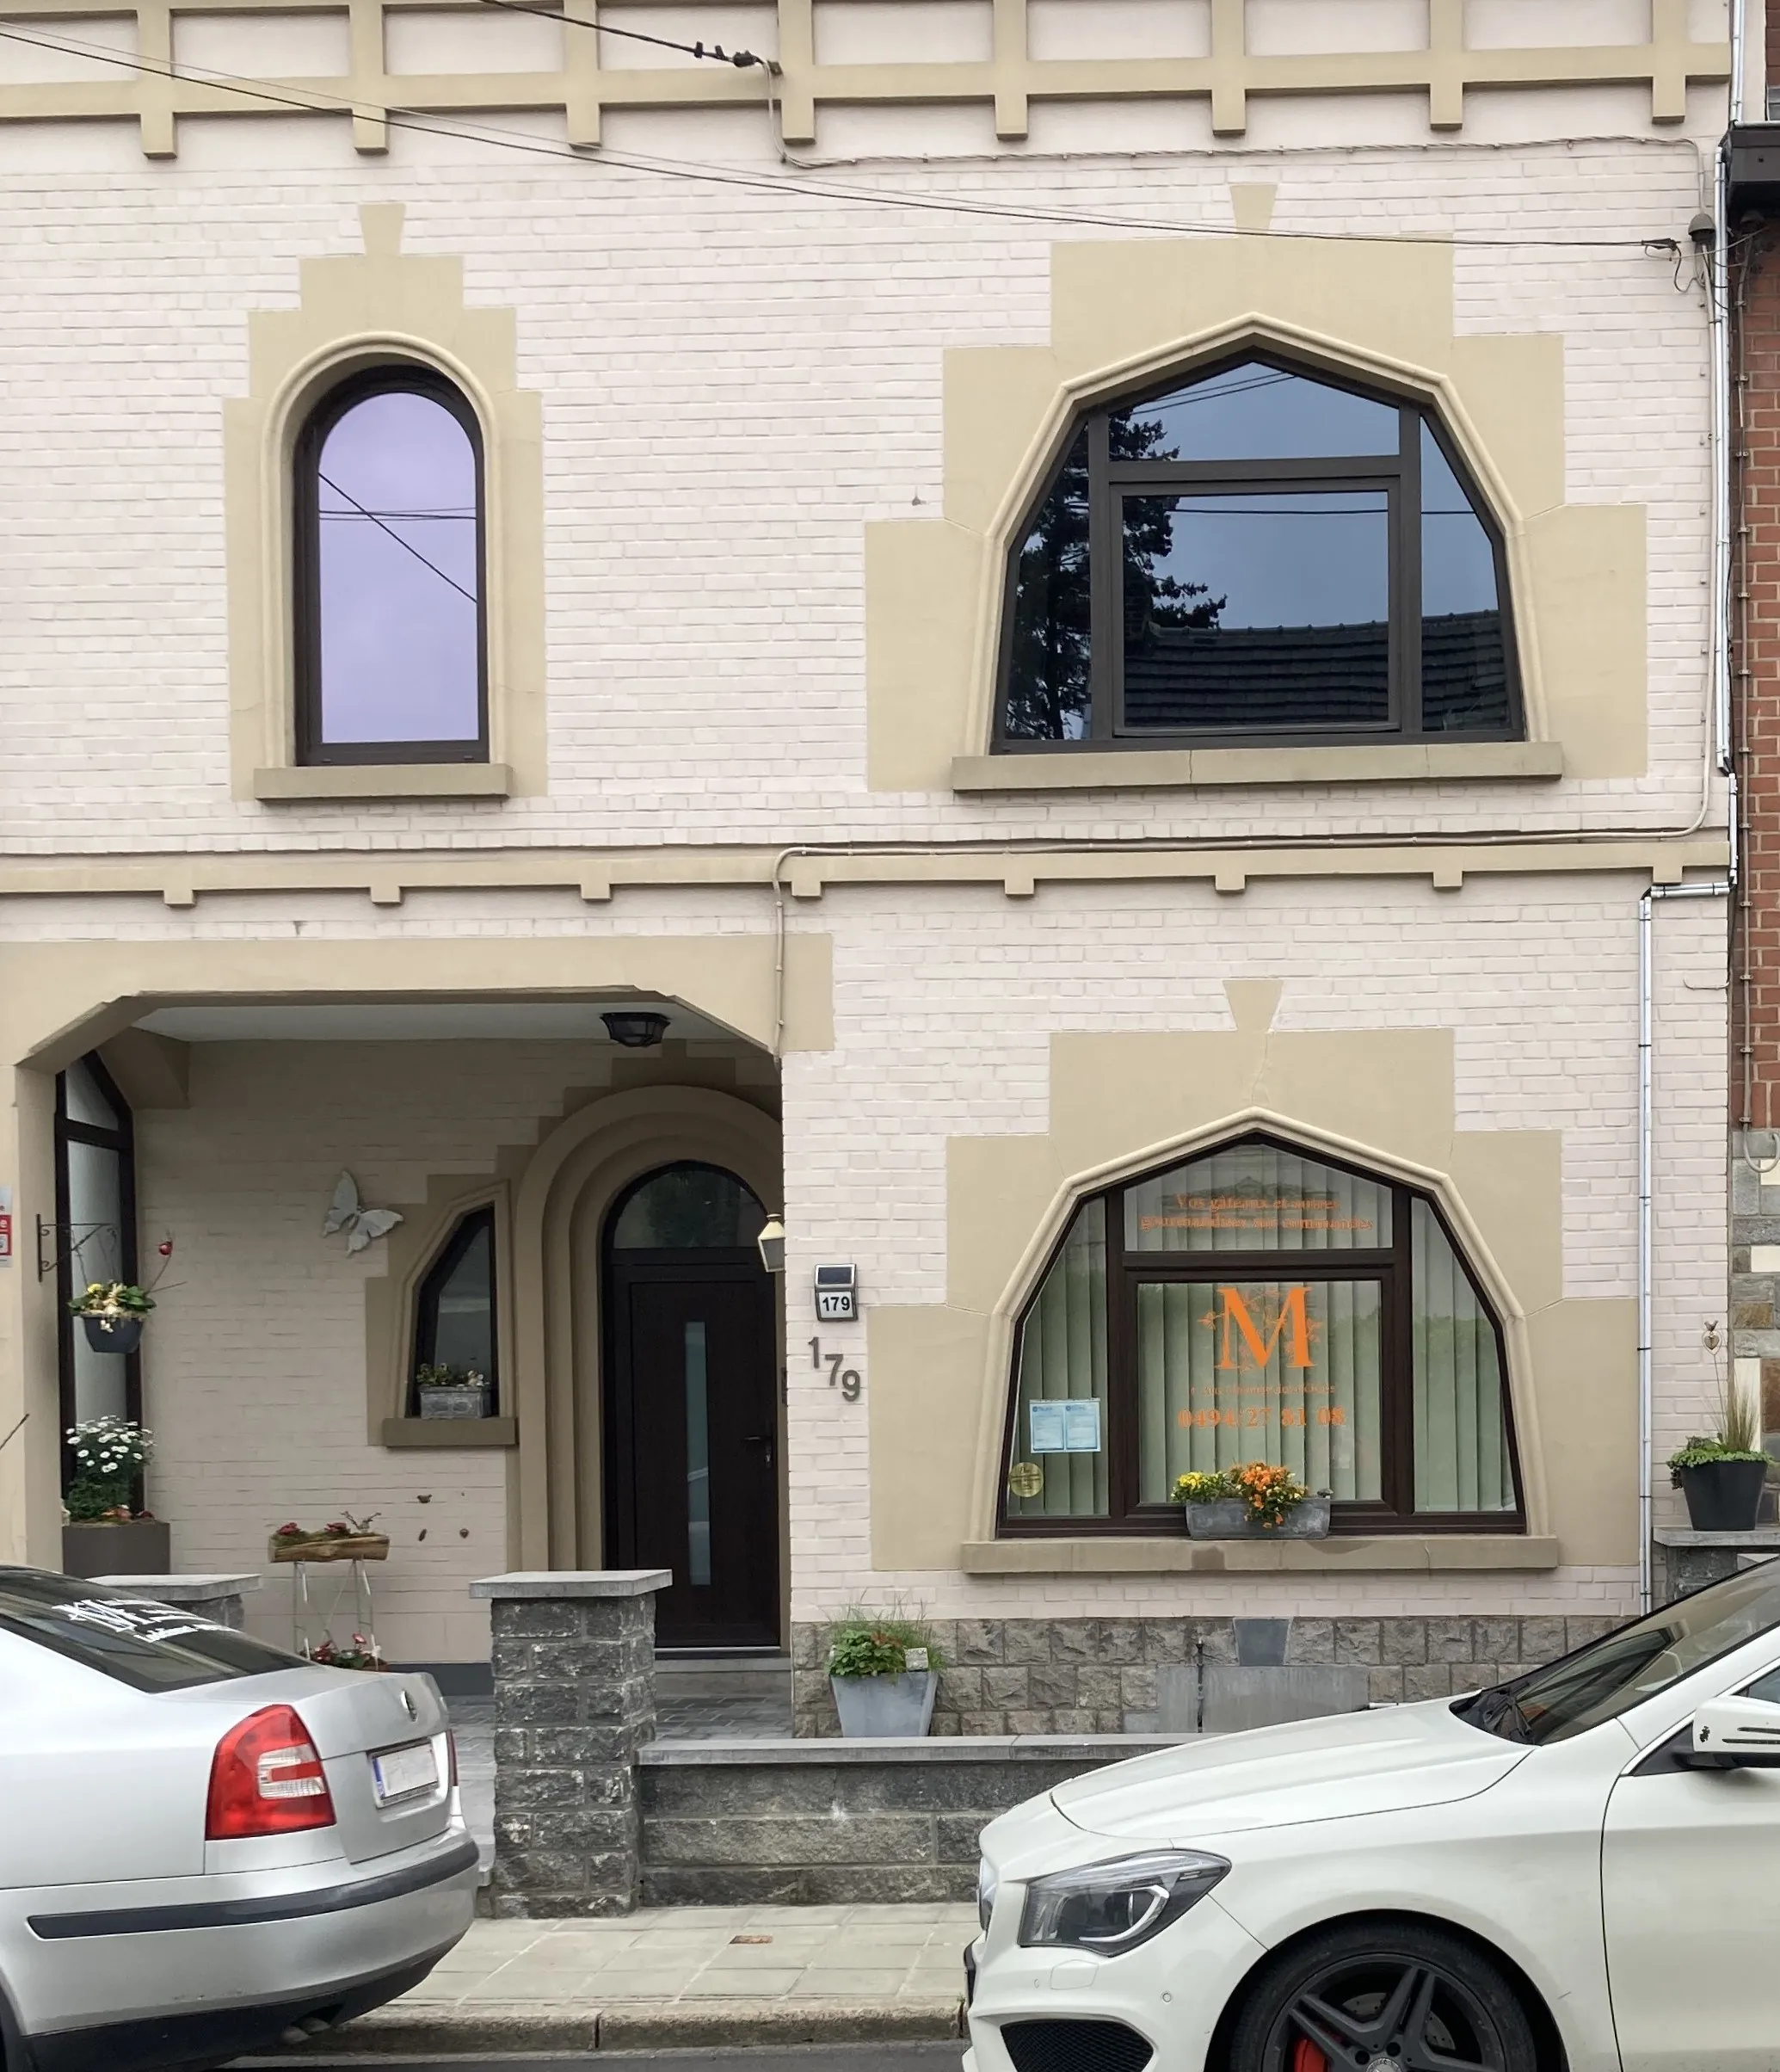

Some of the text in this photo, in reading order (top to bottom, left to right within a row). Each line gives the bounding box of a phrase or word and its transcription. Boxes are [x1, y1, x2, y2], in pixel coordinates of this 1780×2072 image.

[822, 1296, 850, 1311] 179
[1215, 1286, 1316, 1368] M
[808, 1336, 860, 1402] 179
